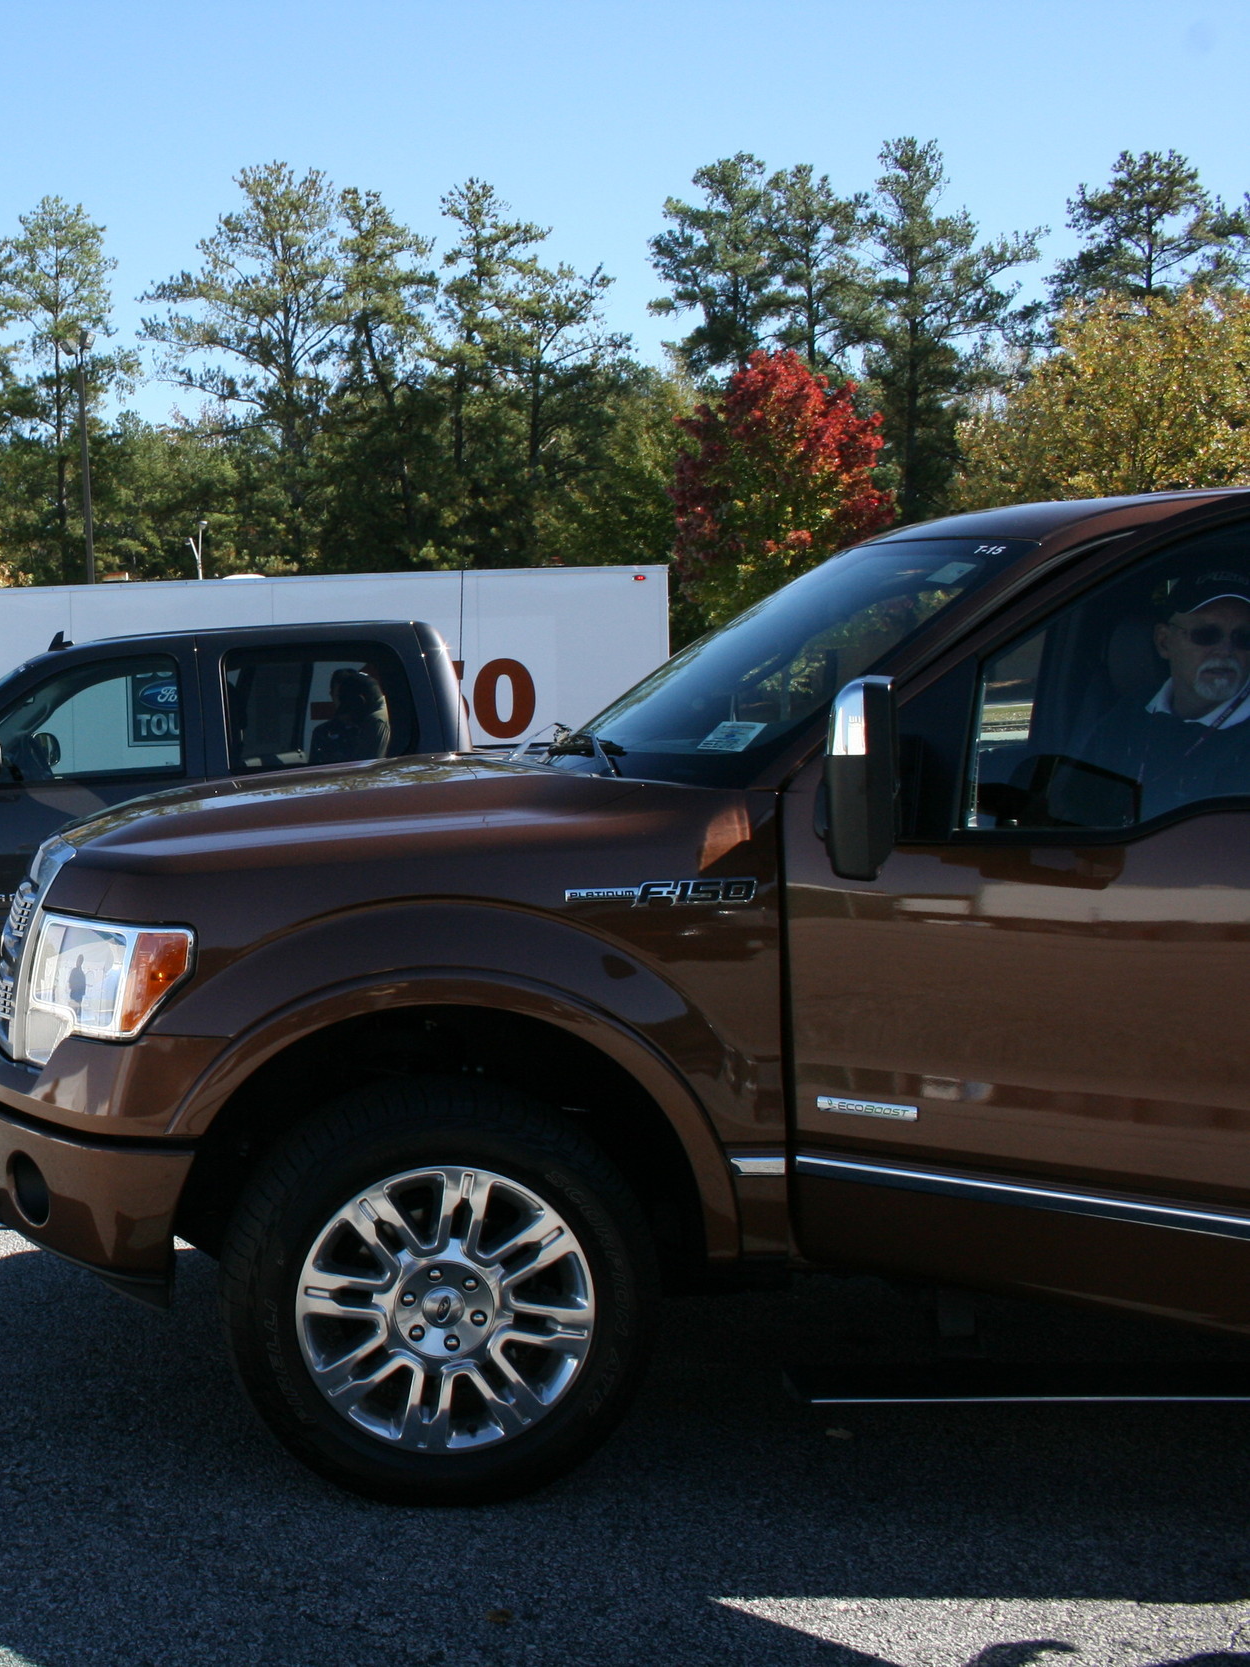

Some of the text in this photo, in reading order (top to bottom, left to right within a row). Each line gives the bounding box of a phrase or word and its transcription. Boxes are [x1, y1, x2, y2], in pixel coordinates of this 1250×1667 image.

[974, 545, 1007, 555] T-15
[157, 686, 178, 703] Fo
[136, 713, 180, 736] TOU
[569, 879, 759, 907] PLATINUM F-150
